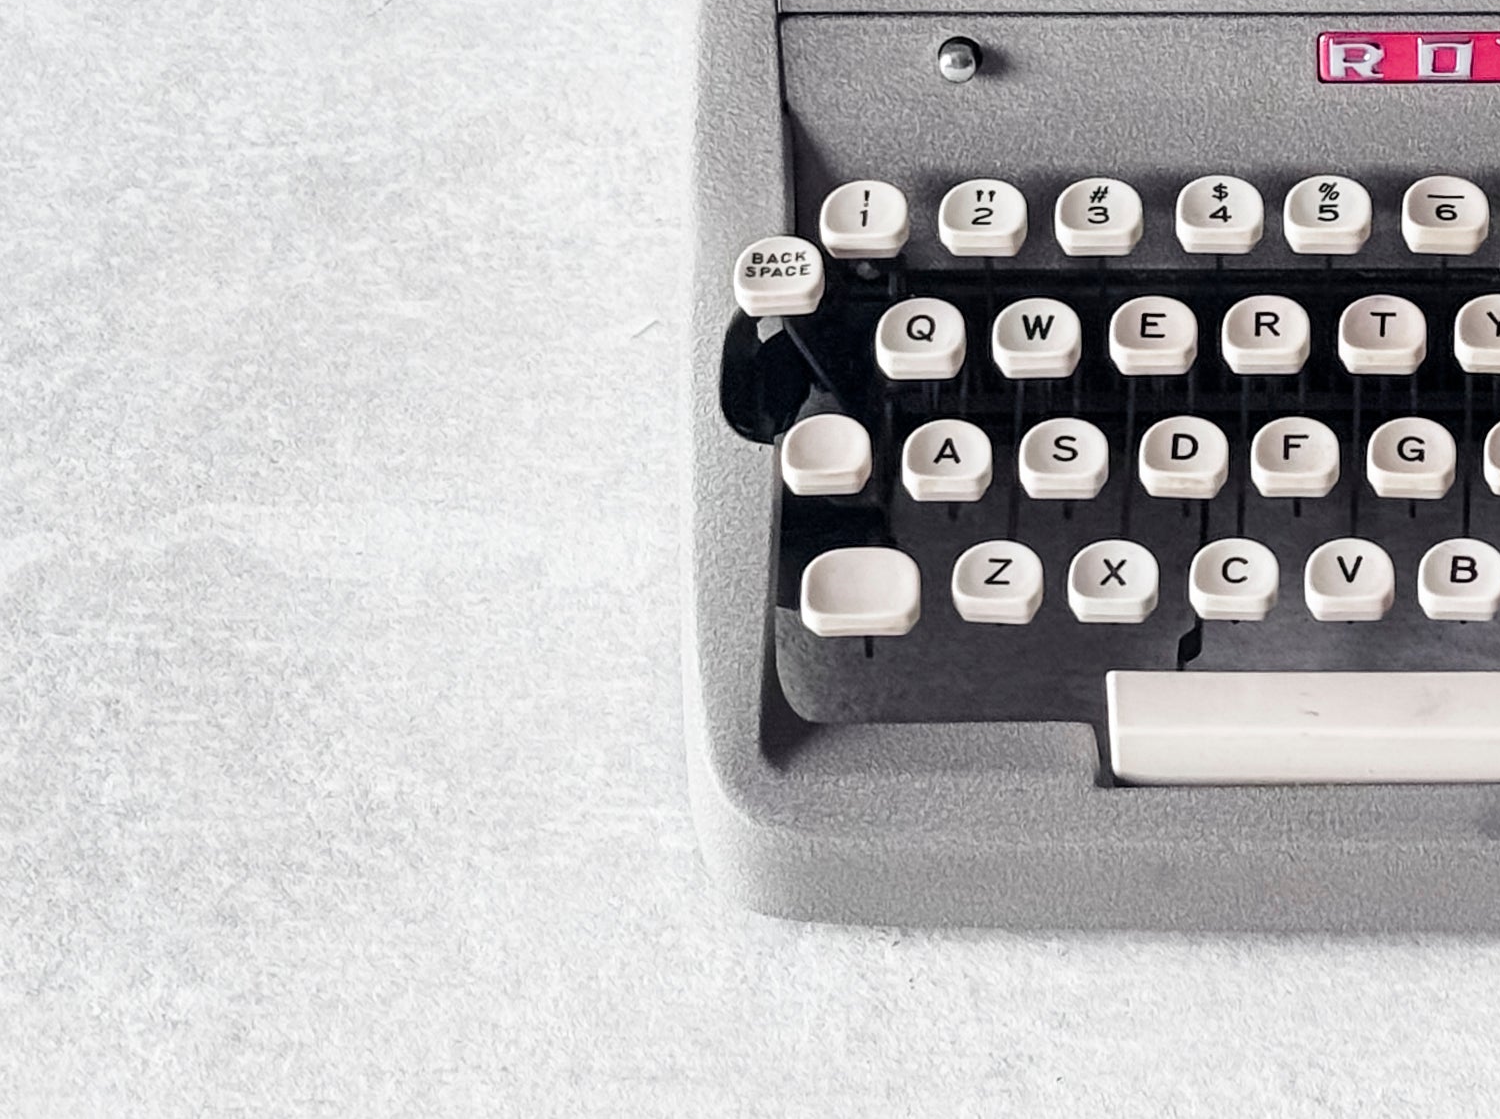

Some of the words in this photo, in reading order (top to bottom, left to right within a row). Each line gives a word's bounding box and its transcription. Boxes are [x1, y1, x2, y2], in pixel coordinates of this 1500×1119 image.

[864, 190, 870, 207] !
[1089, 185, 1109, 204] #
[1211, 182, 1229, 202] $
[1318, 182, 1340, 202] %
[860, 209, 868, 228] 1
[971, 207, 994, 226] 2
[1087, 206, 1110, 225] 3
[1208, 205, 1232, 223] 4
[1317, 204, 1340, 222] 5
[1434, 203, 1458, 222] 6
[744, 263, 812, 279] SPACE
[751, 250, 808, 266] BACK
[906, 314, 936, 343] Q
[1021, 314, 1055, 341] W
[1139, 312, 1167, 339] E
[1254, 311, 1281, 338] R
[1369, 311, 1397, 338] T
[932, 437, 961, 465] A
[1052, 435, 1079, 462] S
[1170, 432, 1199, 461] D
[1282, 434, 1310, 461] F
[1396, 435, 1425, 463] G
[983, 558, 1013, 586] Z
[1099, 558, 1127, 586] X
[1221, 556, 1249, 584] C
[1336, 555, 1363, 584] V
[1449, 555, 1479, 584] B
